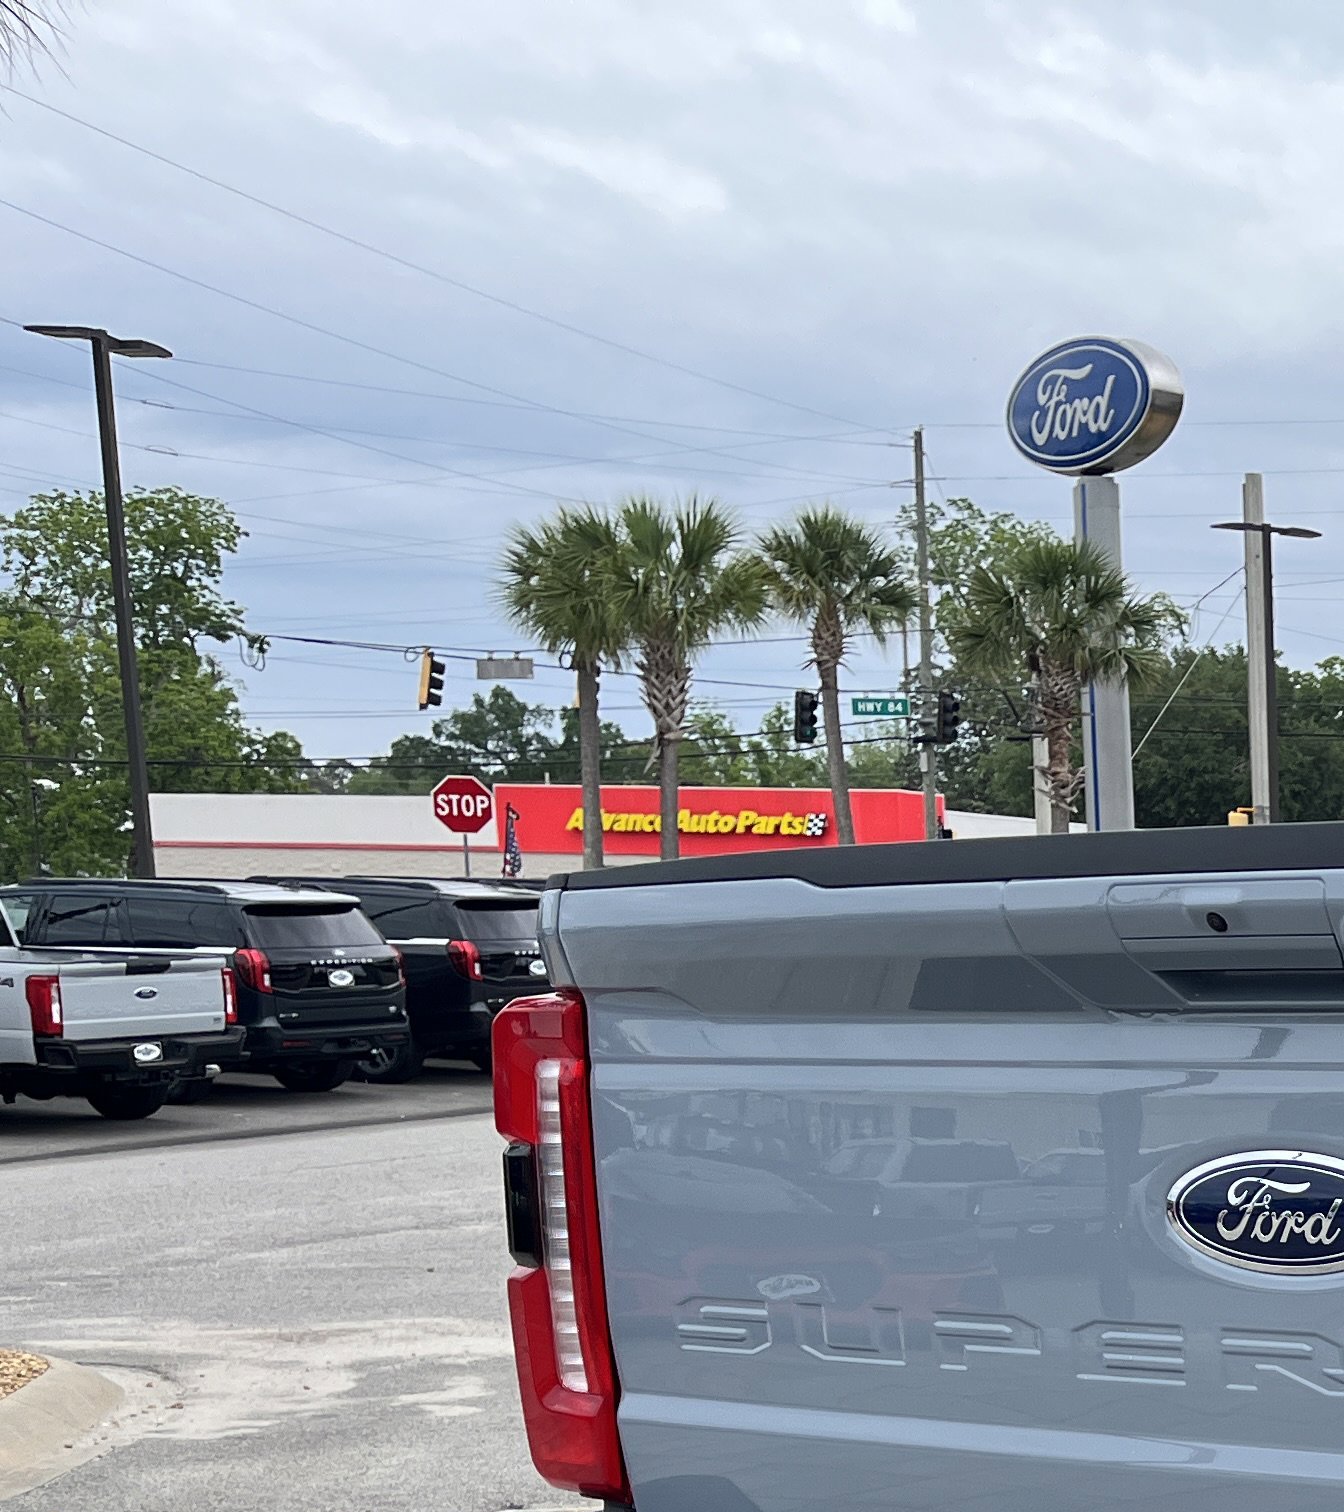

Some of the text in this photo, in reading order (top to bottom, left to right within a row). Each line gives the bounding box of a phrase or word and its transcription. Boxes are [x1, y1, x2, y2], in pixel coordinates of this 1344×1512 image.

[1031, 363, 1116, 446] Ford
[857, 701, 903, 713] HWY 84
[436, 793, 490, 817] STOP
[565, 807, 806, 836] Avanc Auto Parts
[1216, 1176, 1343, 1245] Ford
